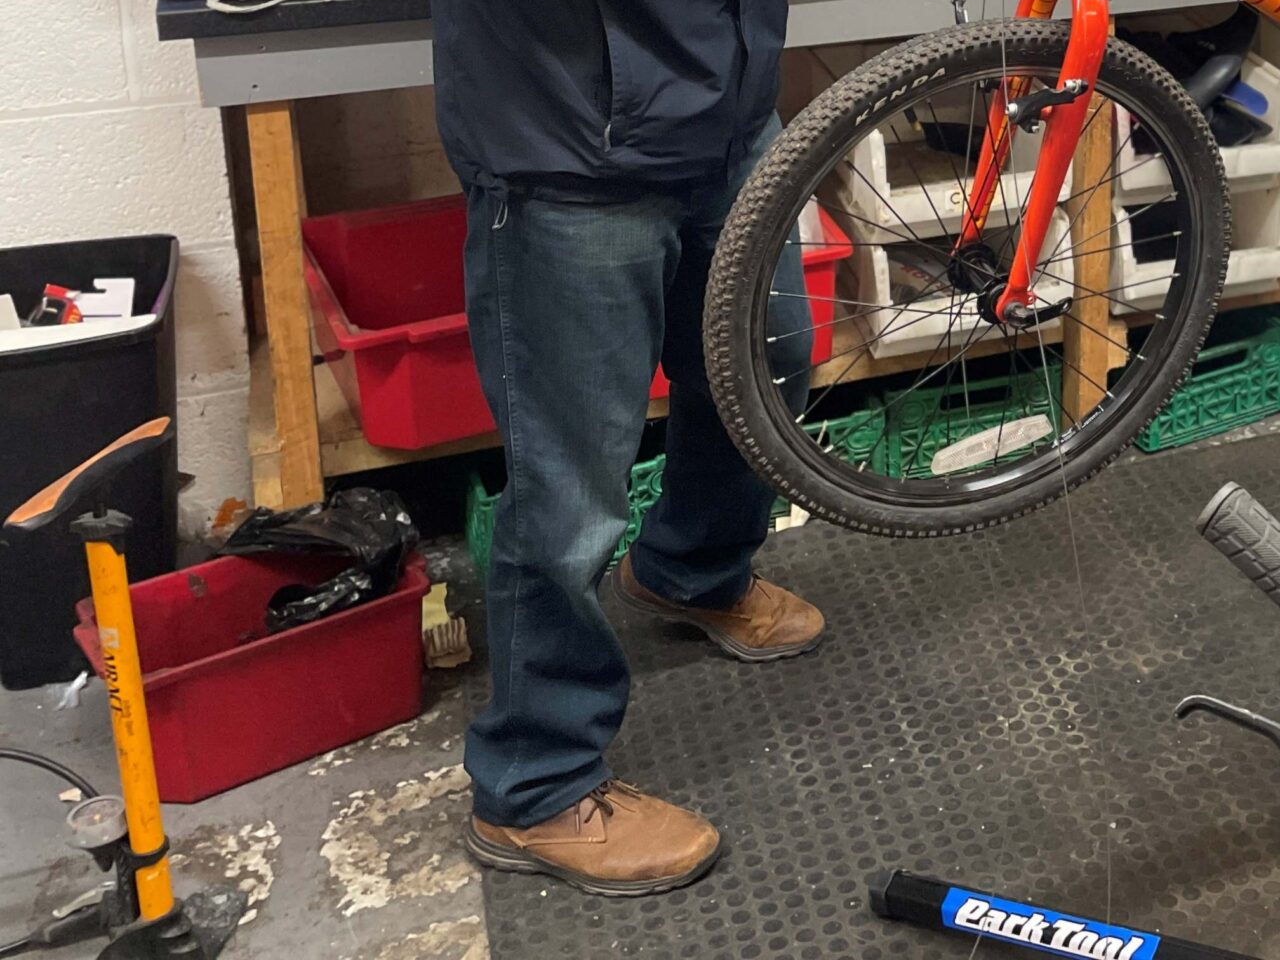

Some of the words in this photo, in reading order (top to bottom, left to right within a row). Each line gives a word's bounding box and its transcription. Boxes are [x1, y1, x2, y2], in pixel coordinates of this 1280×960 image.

[855, 66, 946, 127] KENDA
[954, 896, 1050, 947] Park
[1050, 918, 1145, 960] Tool
